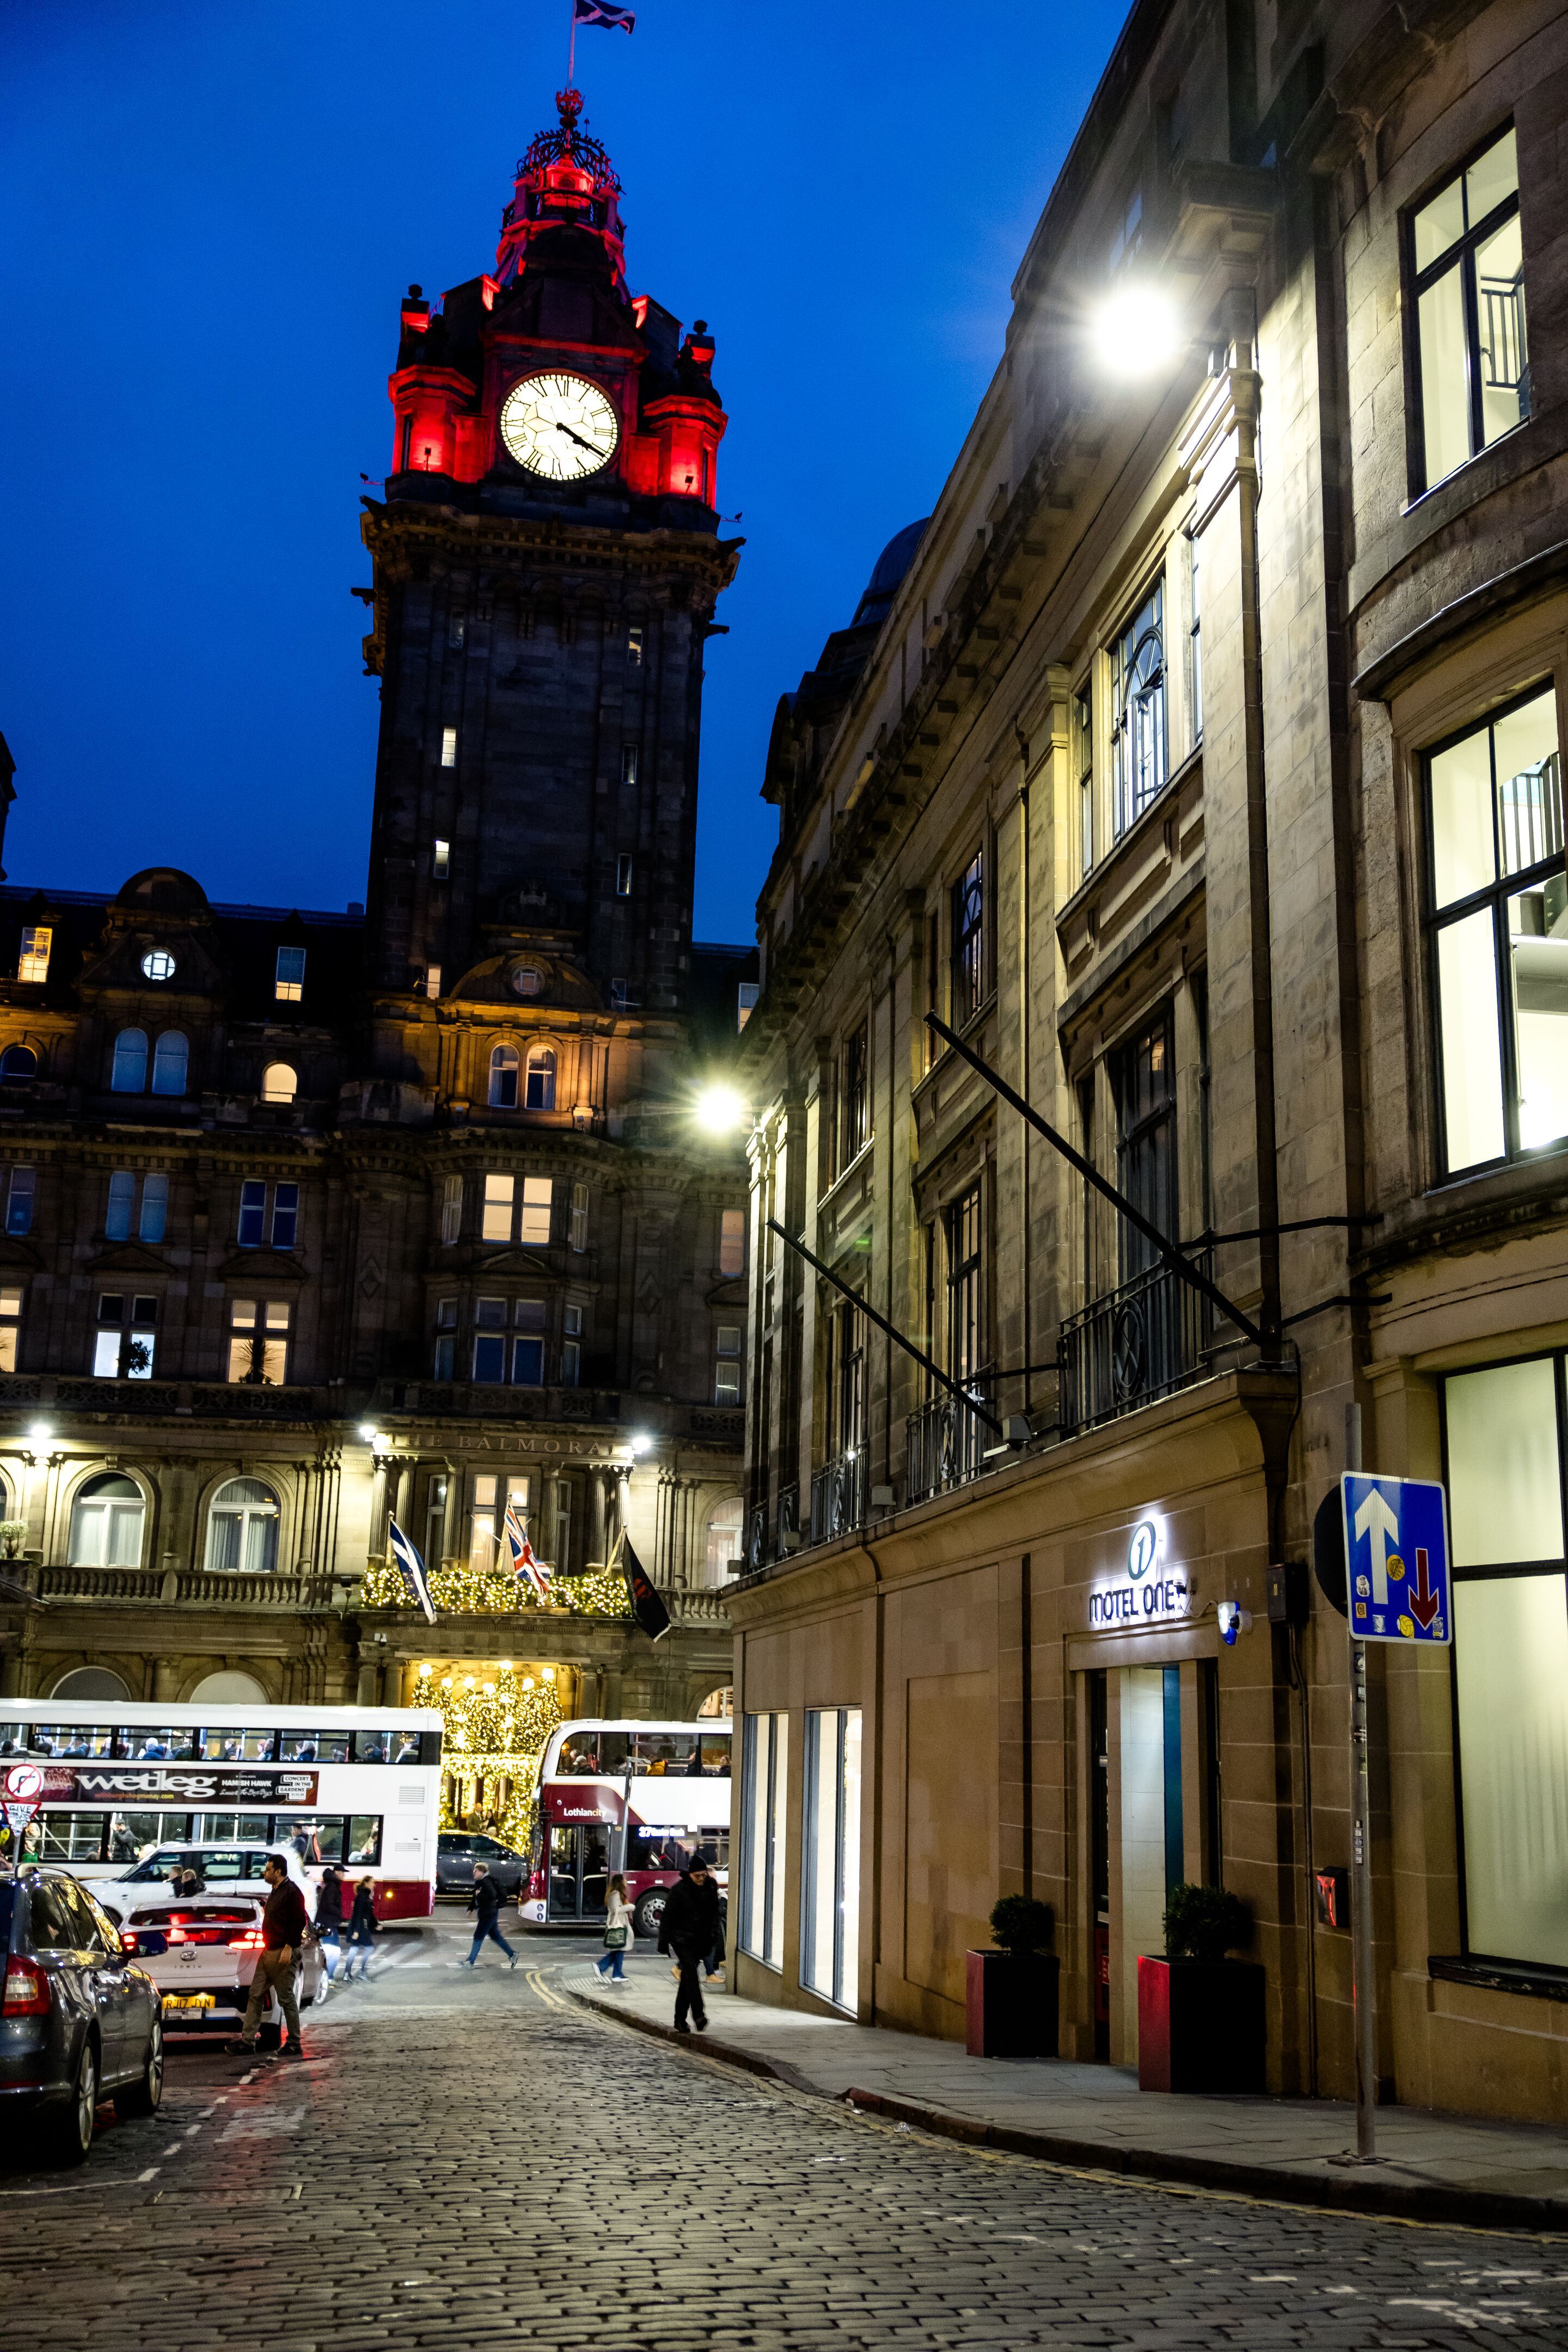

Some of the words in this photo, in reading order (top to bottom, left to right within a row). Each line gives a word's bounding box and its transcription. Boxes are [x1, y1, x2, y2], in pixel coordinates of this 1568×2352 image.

[387, 1433, 442, 1447] HE
[1089, 1588, 1139, 1622] MOTEL
[1143, 1580, 1175, 1615] ONE
[9, 1805, 32, 1814] GIVE
[564, 1808, 607, 1817] Lothiancity
